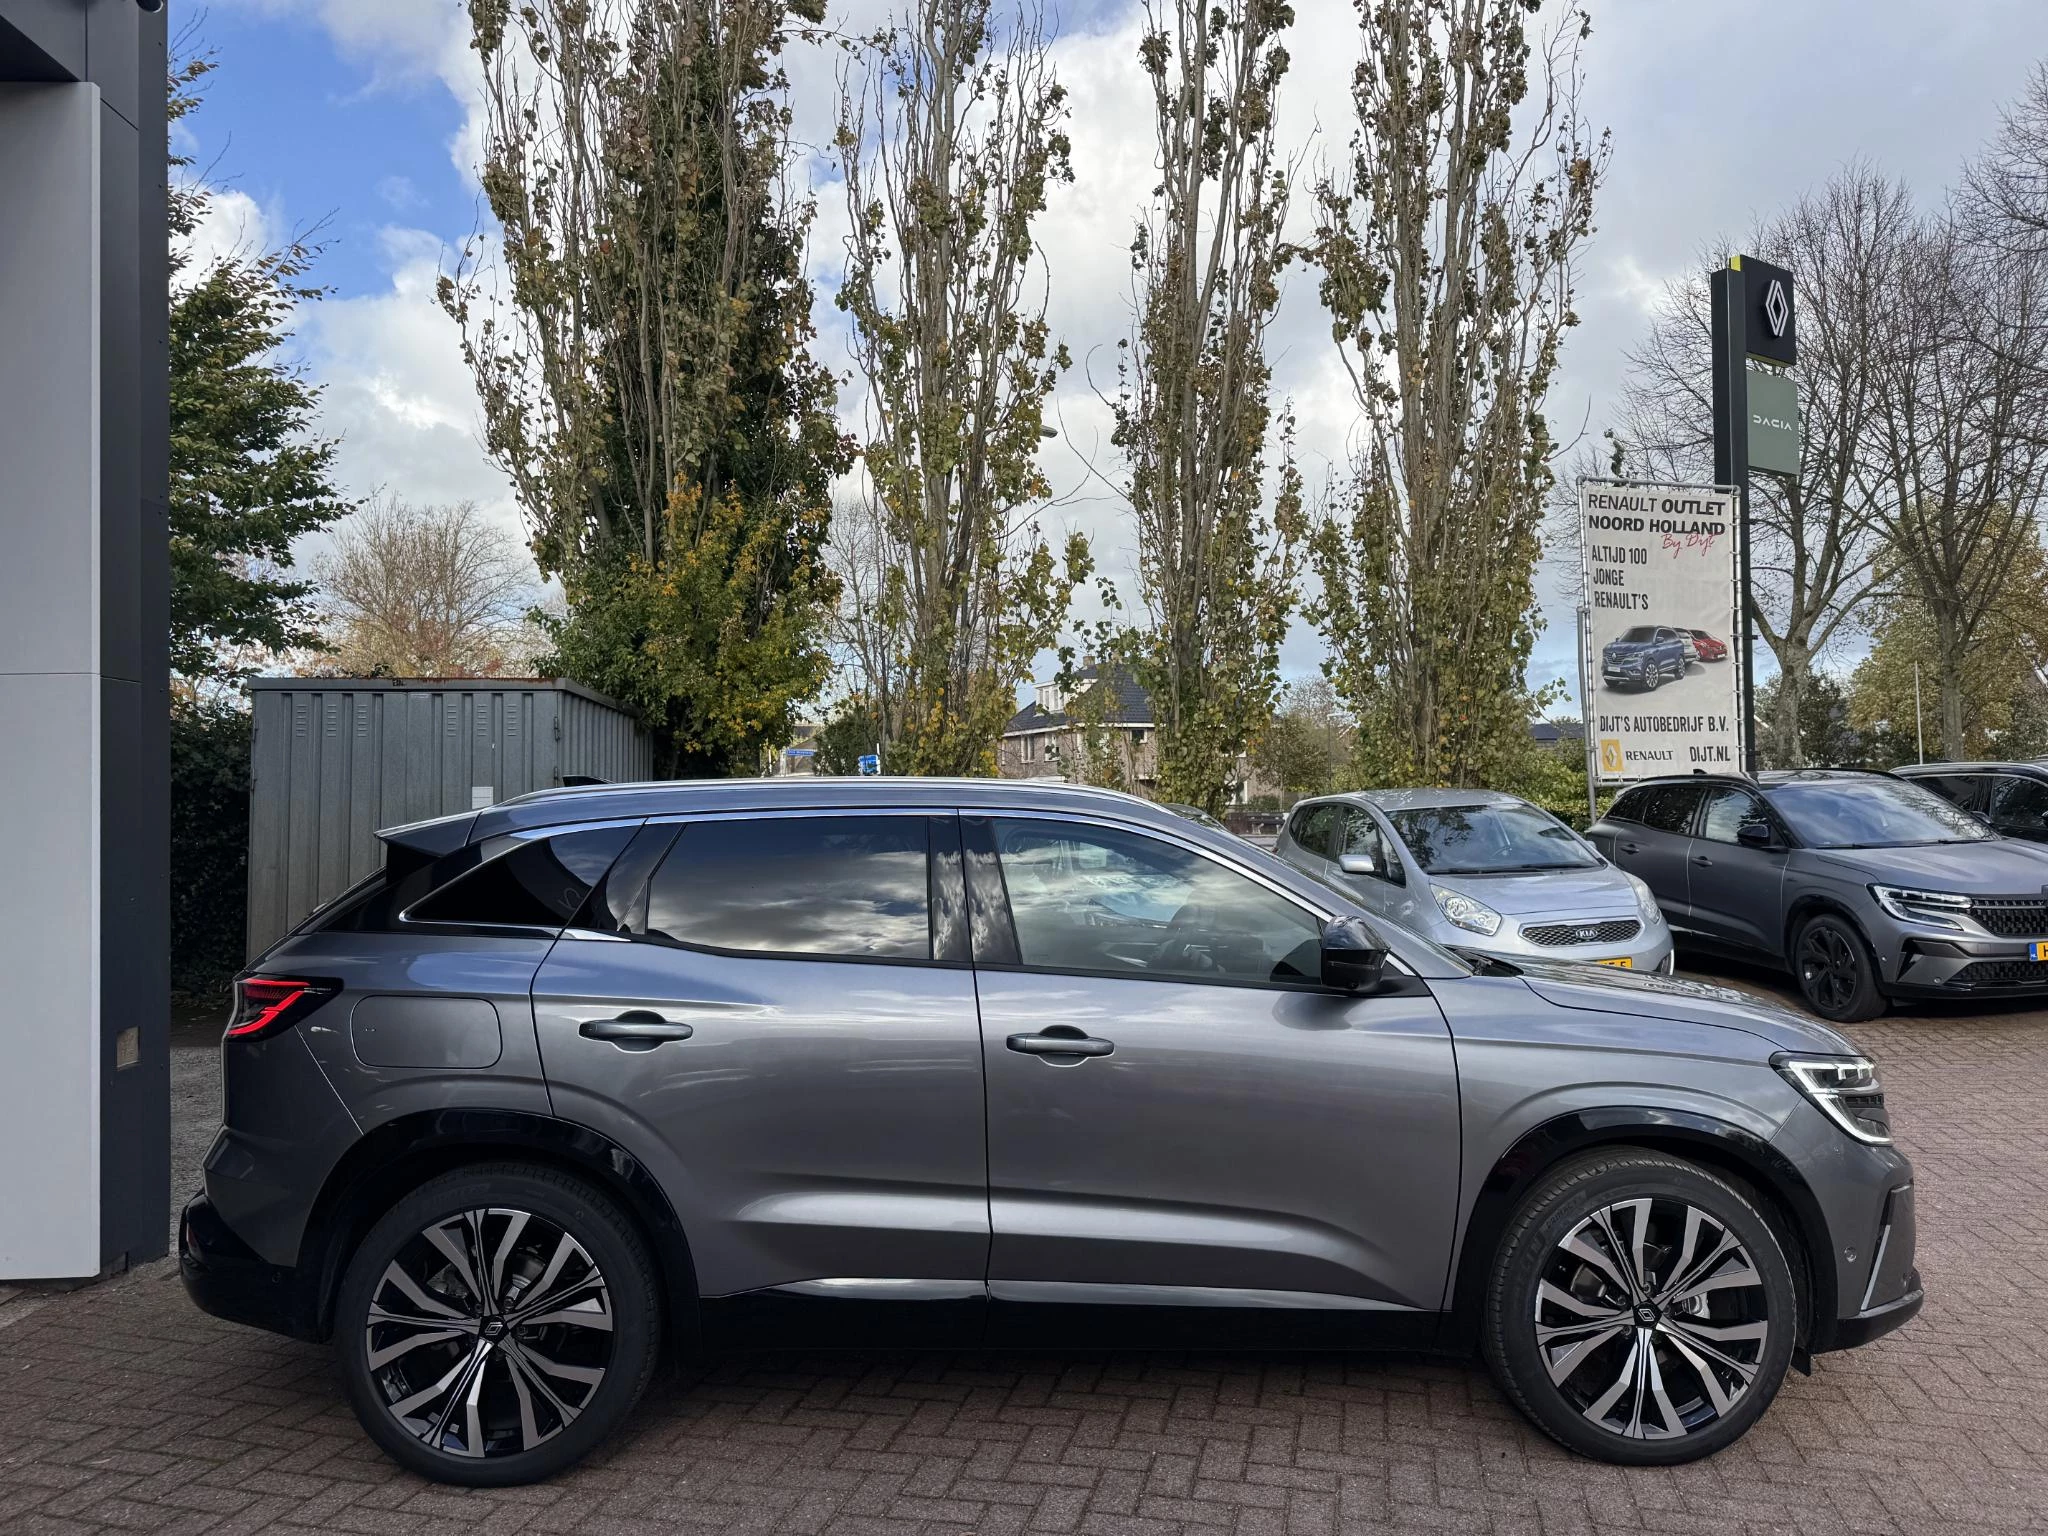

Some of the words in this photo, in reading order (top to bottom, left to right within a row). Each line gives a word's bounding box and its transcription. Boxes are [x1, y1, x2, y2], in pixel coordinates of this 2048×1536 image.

[1753, 414, 1792, 431] DACIA
[1588, 494, 1657, 512] RENAULT
[1661, 499, 1725, 516] OUTLET
[1588, 515, 1644, 532] NOORD
[1650, 519, 1725, 535] HOLLAND
[1592, 545, 1626, 564] ALTIJD
[1628, 547, 1647, 565] 100
[1661, 533, 1682, 559] By
[1593, 568, 1624, 586] JONGE
[1594, 591, 1648, 610] RENAULT'S
[1599, 715, 1630, 732] DIJT'S
[1633, 716, 1704, 732] AUTOBEDRIJF
[1708, 716, 1729, 732] B.V.
[1625, 750, 1674, 760] RENAULT
[1689, 746, 1731, 762] DIJT.NL
[1579, 928, 1596, 937] KIA
